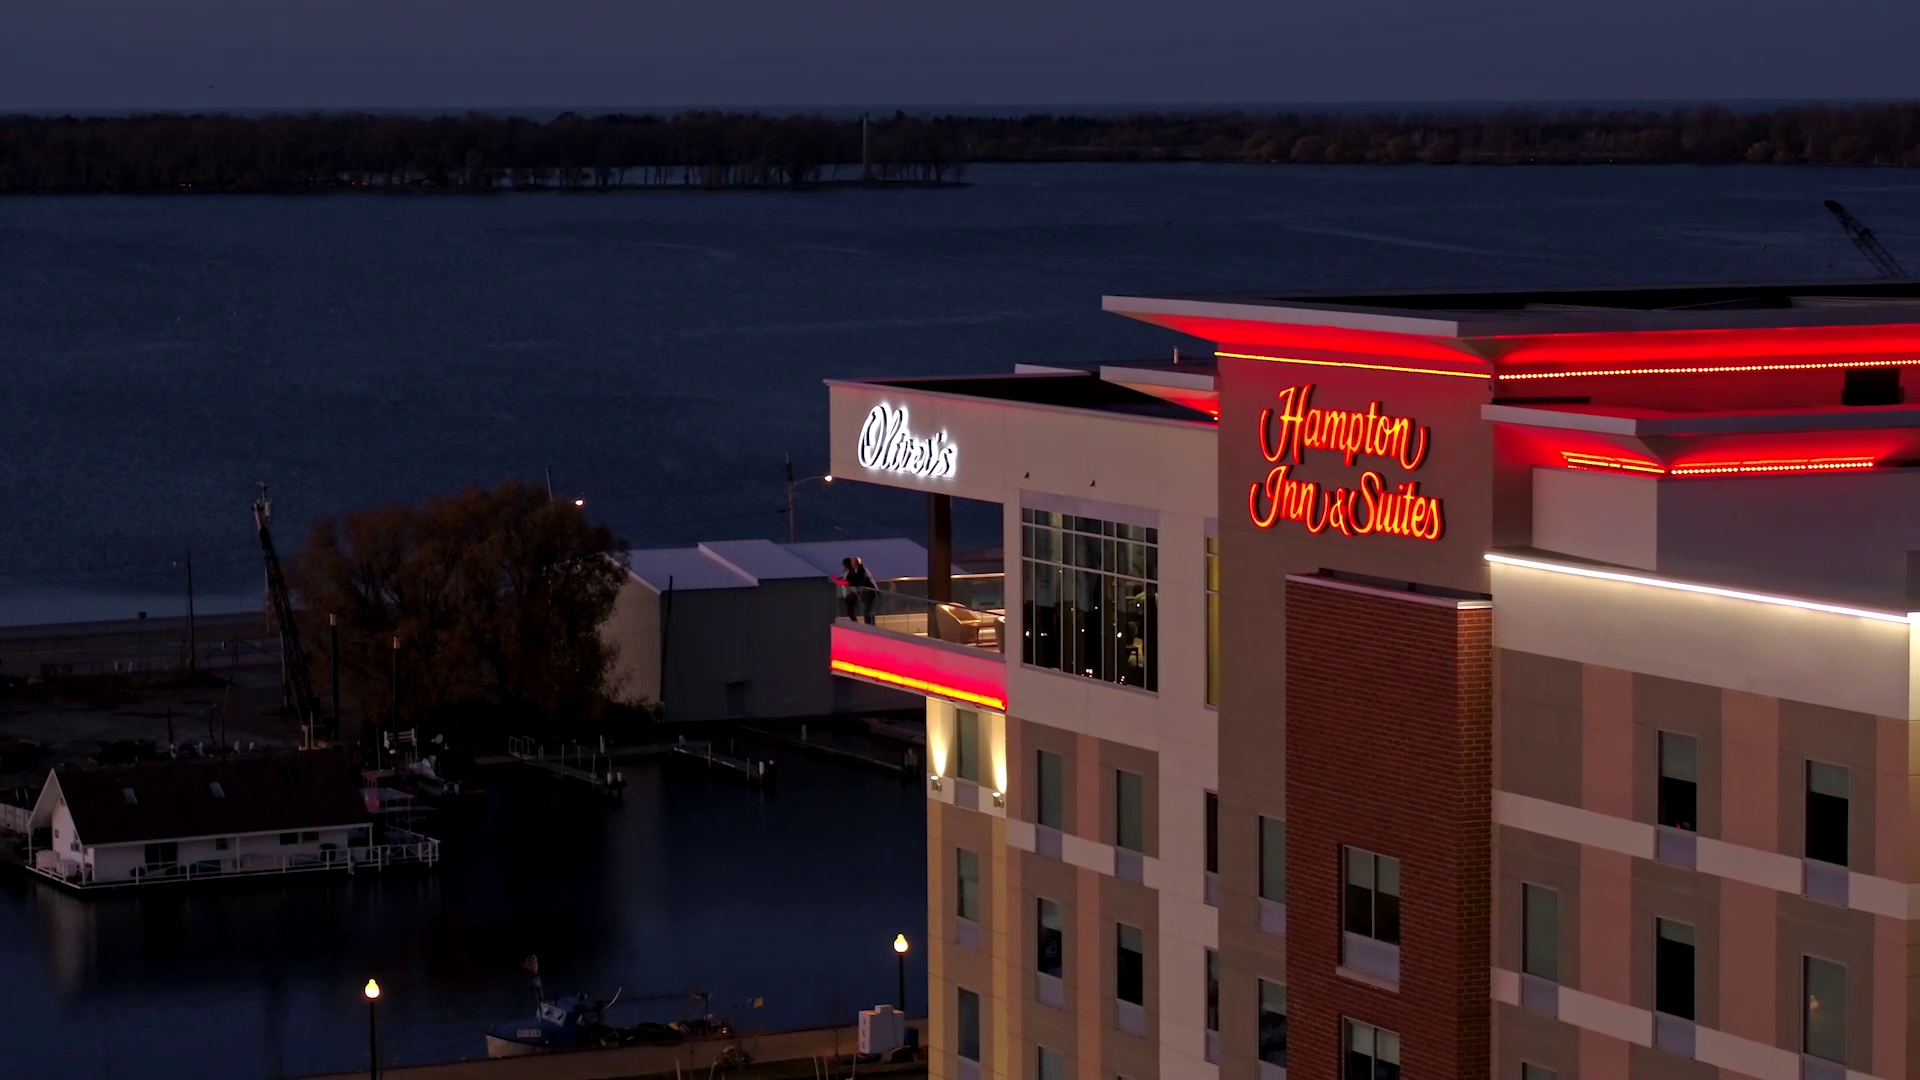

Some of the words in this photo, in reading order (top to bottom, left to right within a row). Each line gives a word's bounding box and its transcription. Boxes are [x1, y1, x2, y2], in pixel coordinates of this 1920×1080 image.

[858, 403, 956, 477] Oliver's
[1259, 384, 1428, 471] Hampton
[1249, 465, 1331, 533] Inn
[1329, 487, 1352, 536] &
[1348, 470, 1442, 540] Suites
